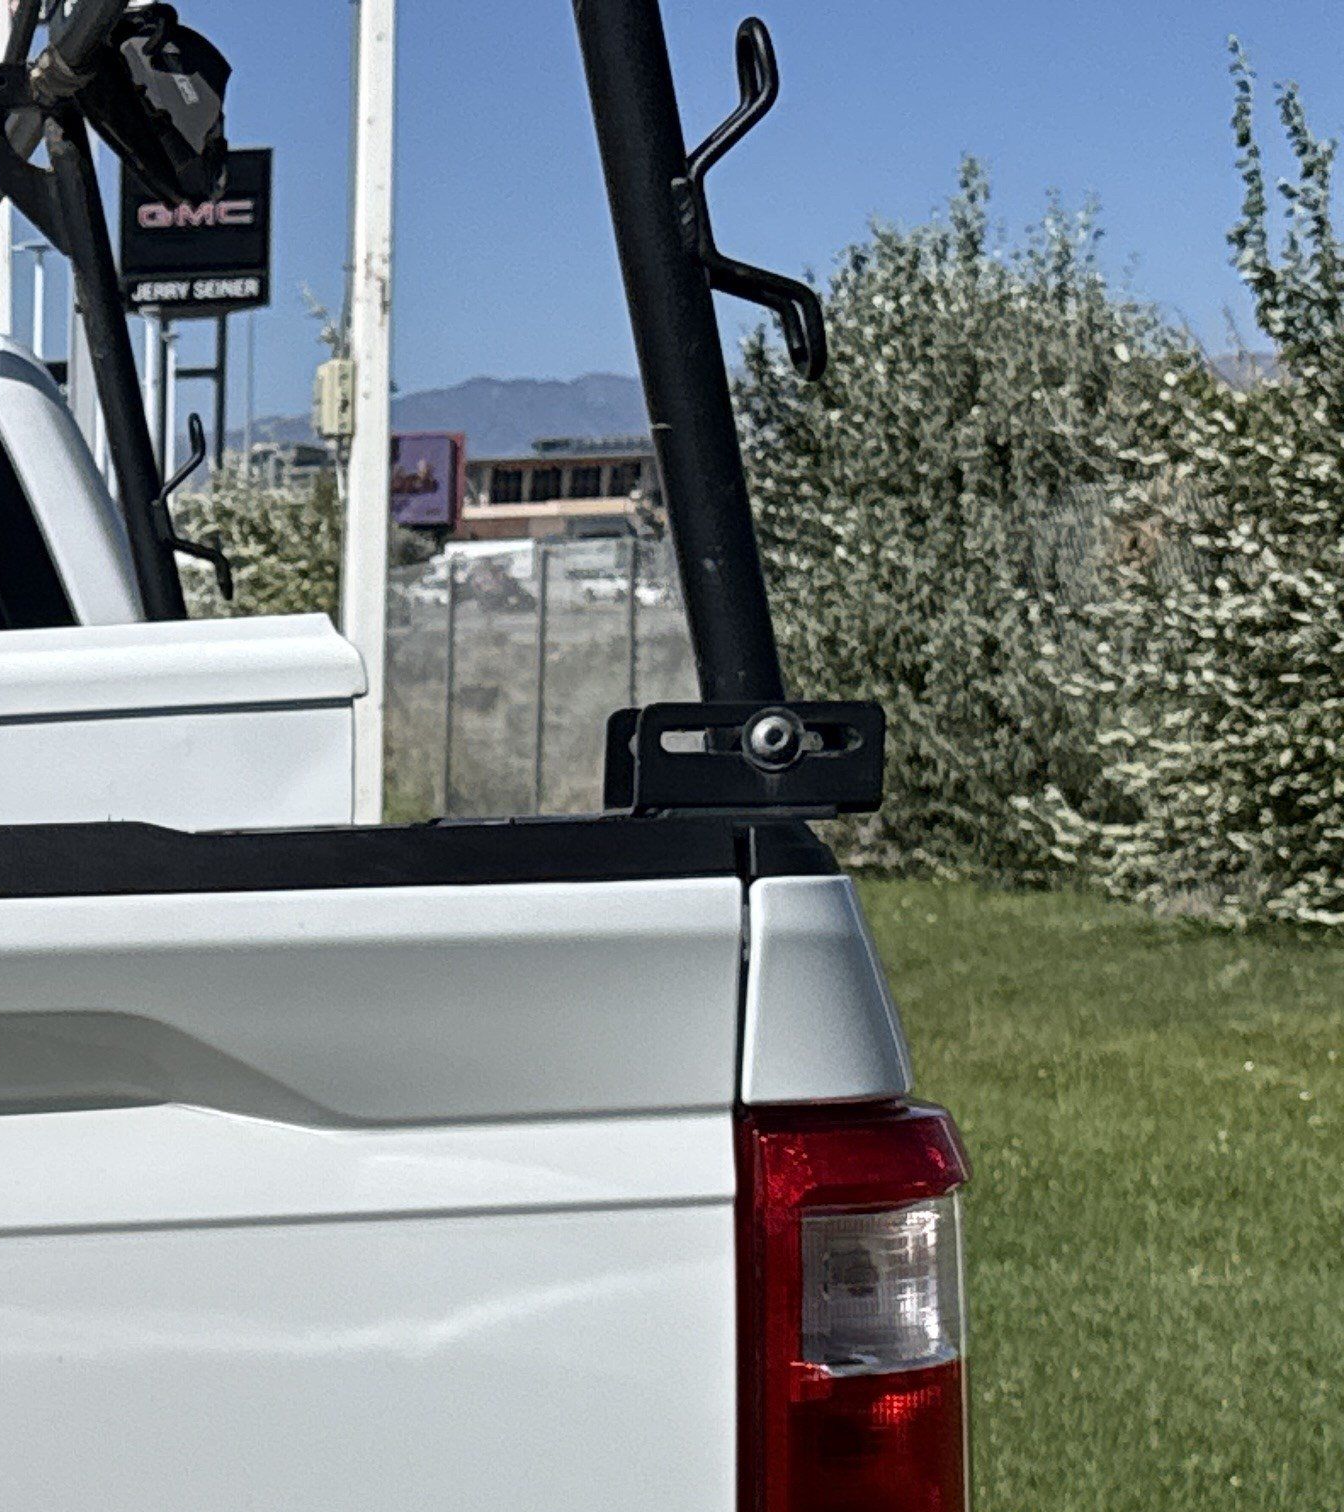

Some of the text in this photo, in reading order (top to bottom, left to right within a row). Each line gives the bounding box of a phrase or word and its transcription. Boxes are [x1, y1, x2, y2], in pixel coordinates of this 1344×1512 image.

[137, 199, 254, 229] GMC
[131, 277, 260, 302] JERRY SEINER
